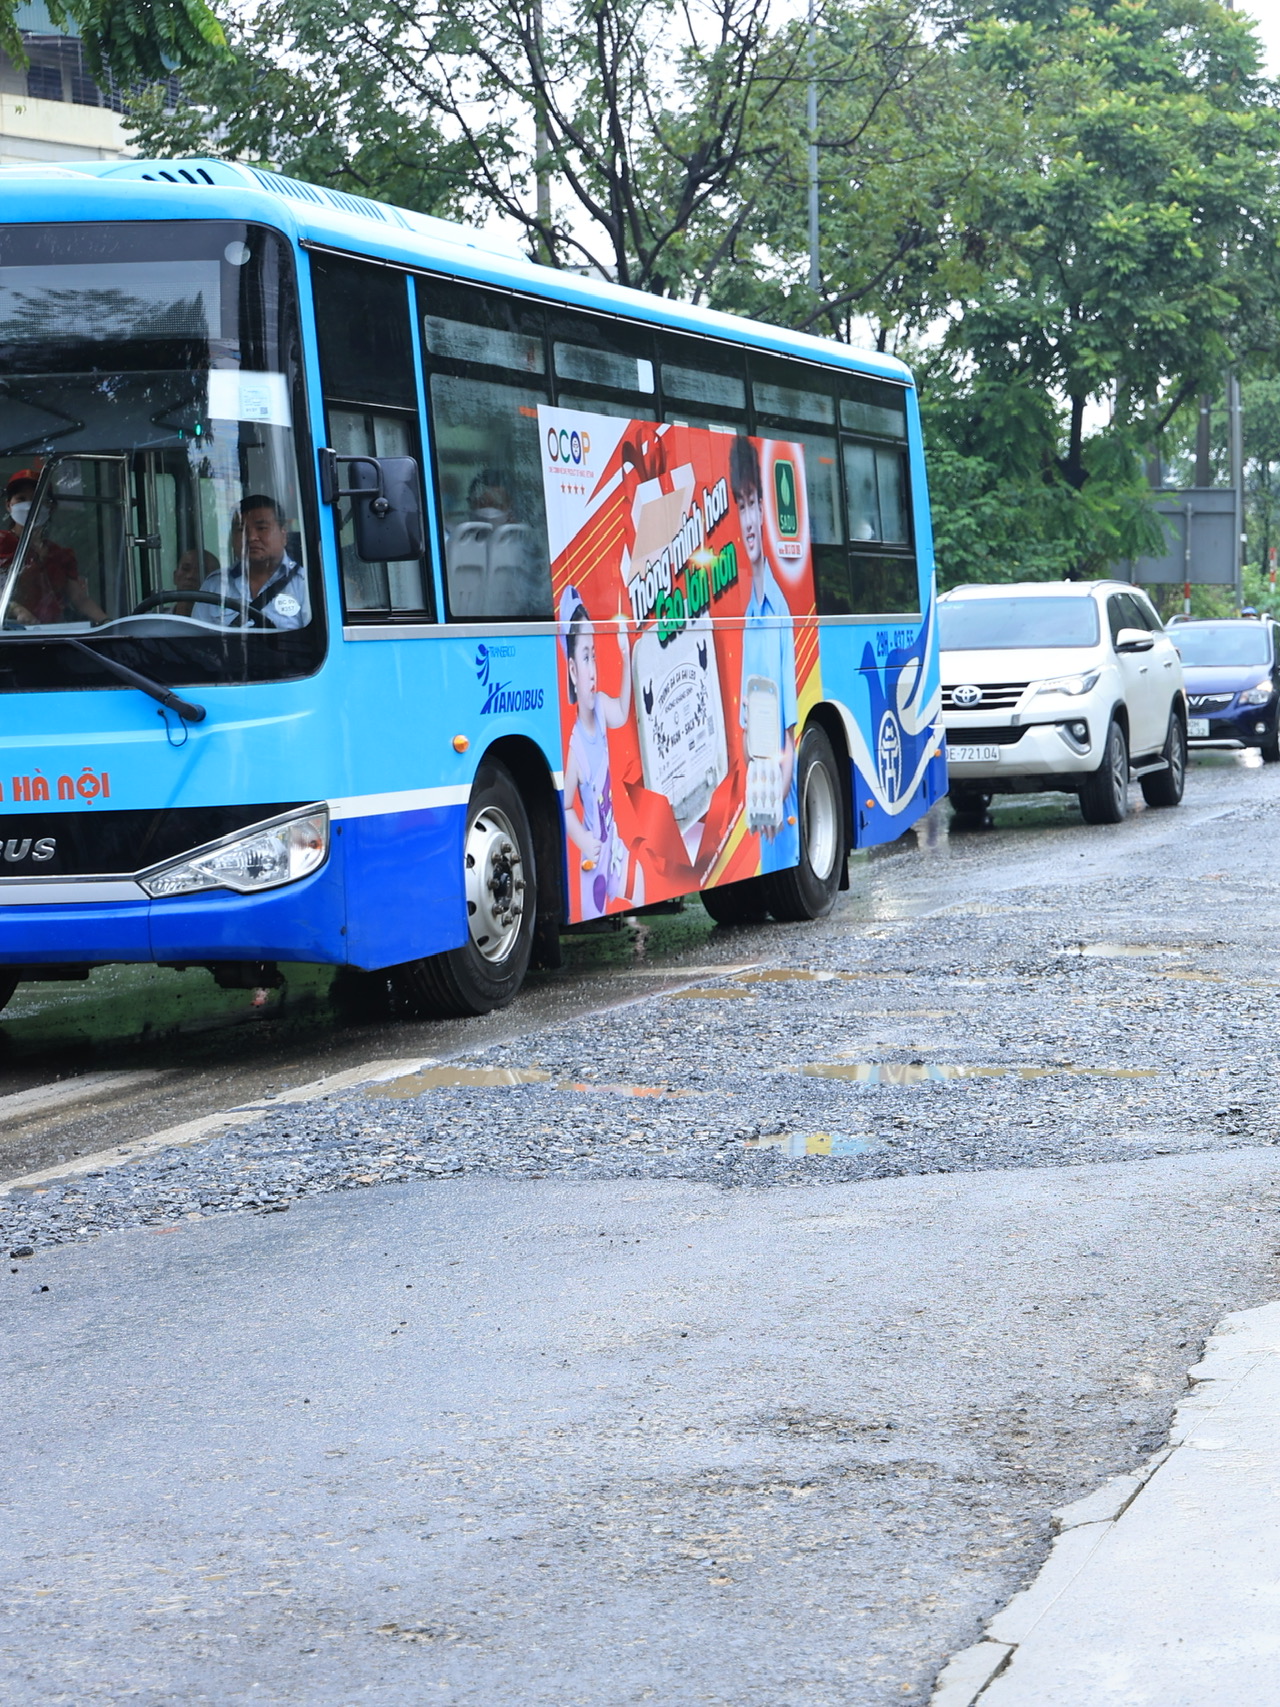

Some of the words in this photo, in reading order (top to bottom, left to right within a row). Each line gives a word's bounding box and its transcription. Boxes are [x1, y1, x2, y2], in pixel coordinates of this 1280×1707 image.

[547, 427, 590, 466] OCOP
[780, 514, 796, 531] SADU
[628, 546, 672, 629] Thông
[671, 501, 702, 575] minh
[702, 477, 729, 534] hơn
[656, 588, 685, 643] Cao
[684, 562, 710, 618] lớn
[709, 541, 738, 596] hơn
[480, 680, 544, 715] HANOIBUS
[12, 768, 50, 802] HÀ
[57, 766, 110, 806] NỘI
